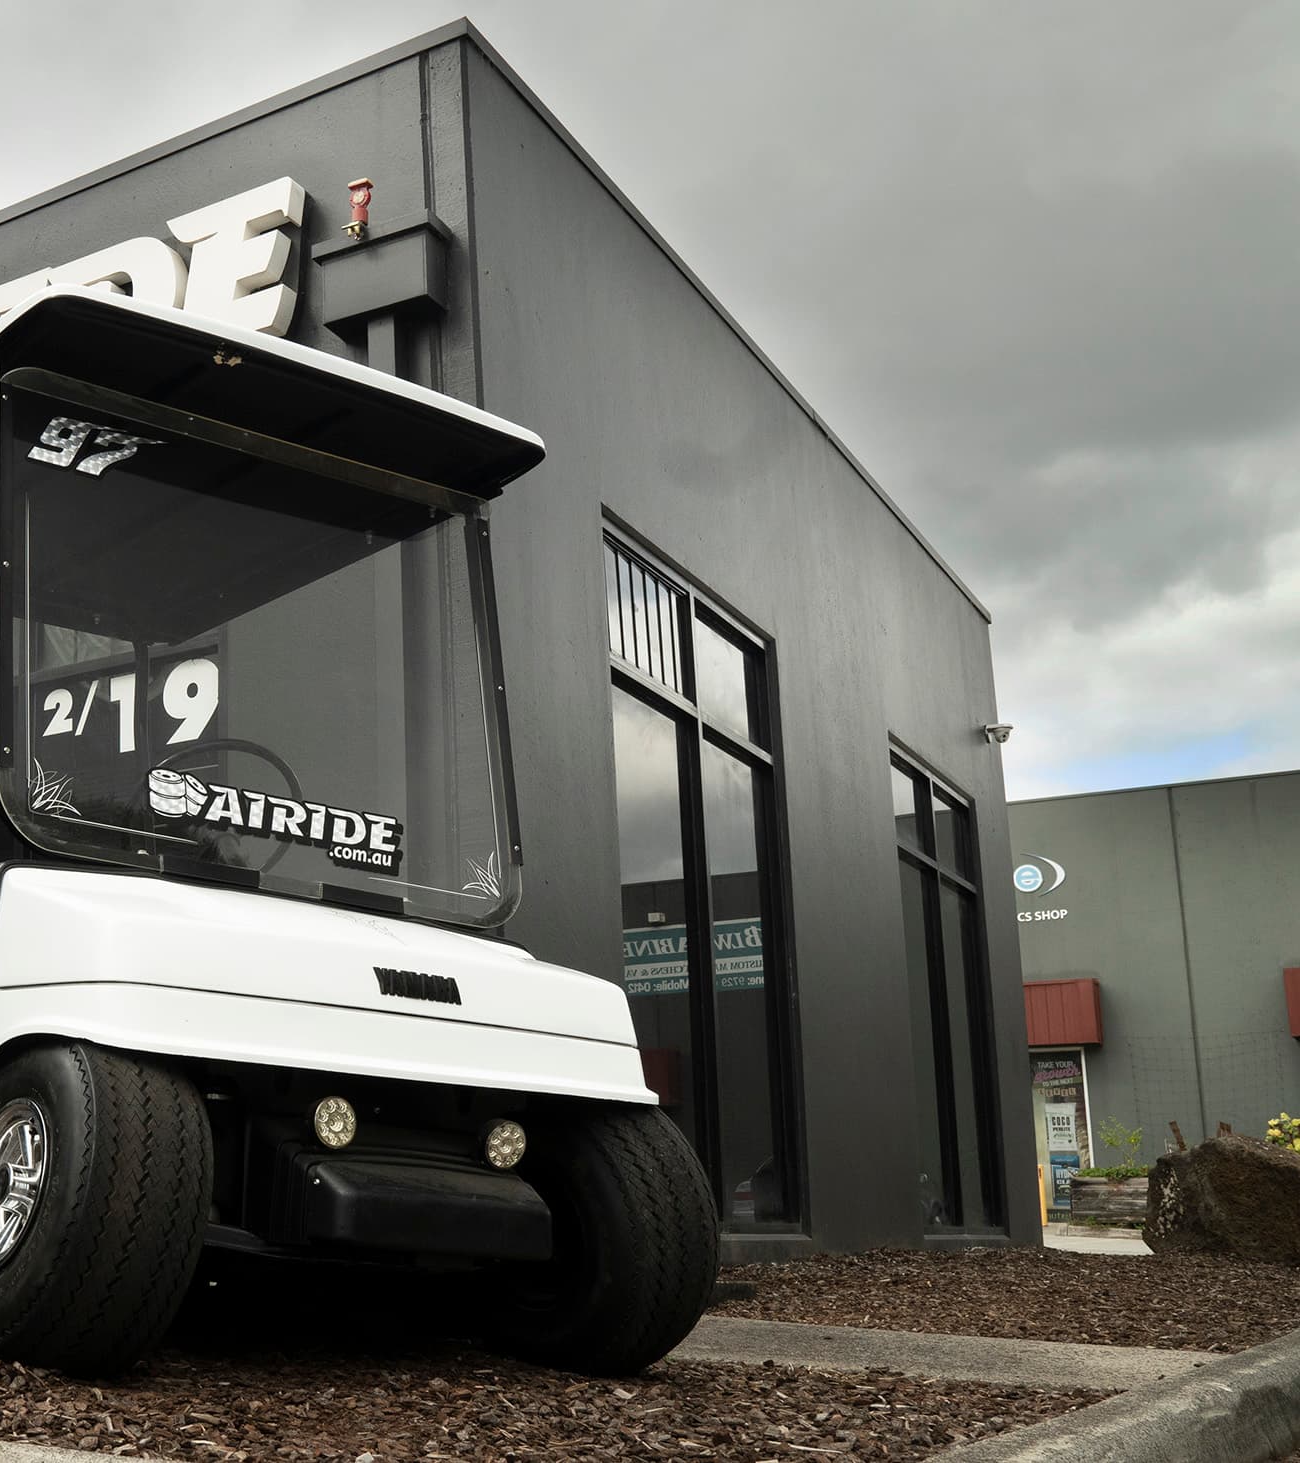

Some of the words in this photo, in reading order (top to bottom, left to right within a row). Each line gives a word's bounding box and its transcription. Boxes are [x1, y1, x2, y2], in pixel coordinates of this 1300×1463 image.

[27, 416, 168, 477] 97
[203, 783, 398, 854] AIRIDE
[328, 842, 393, 868] .com.au
[1034, 909, 1068, 922] SHOP
